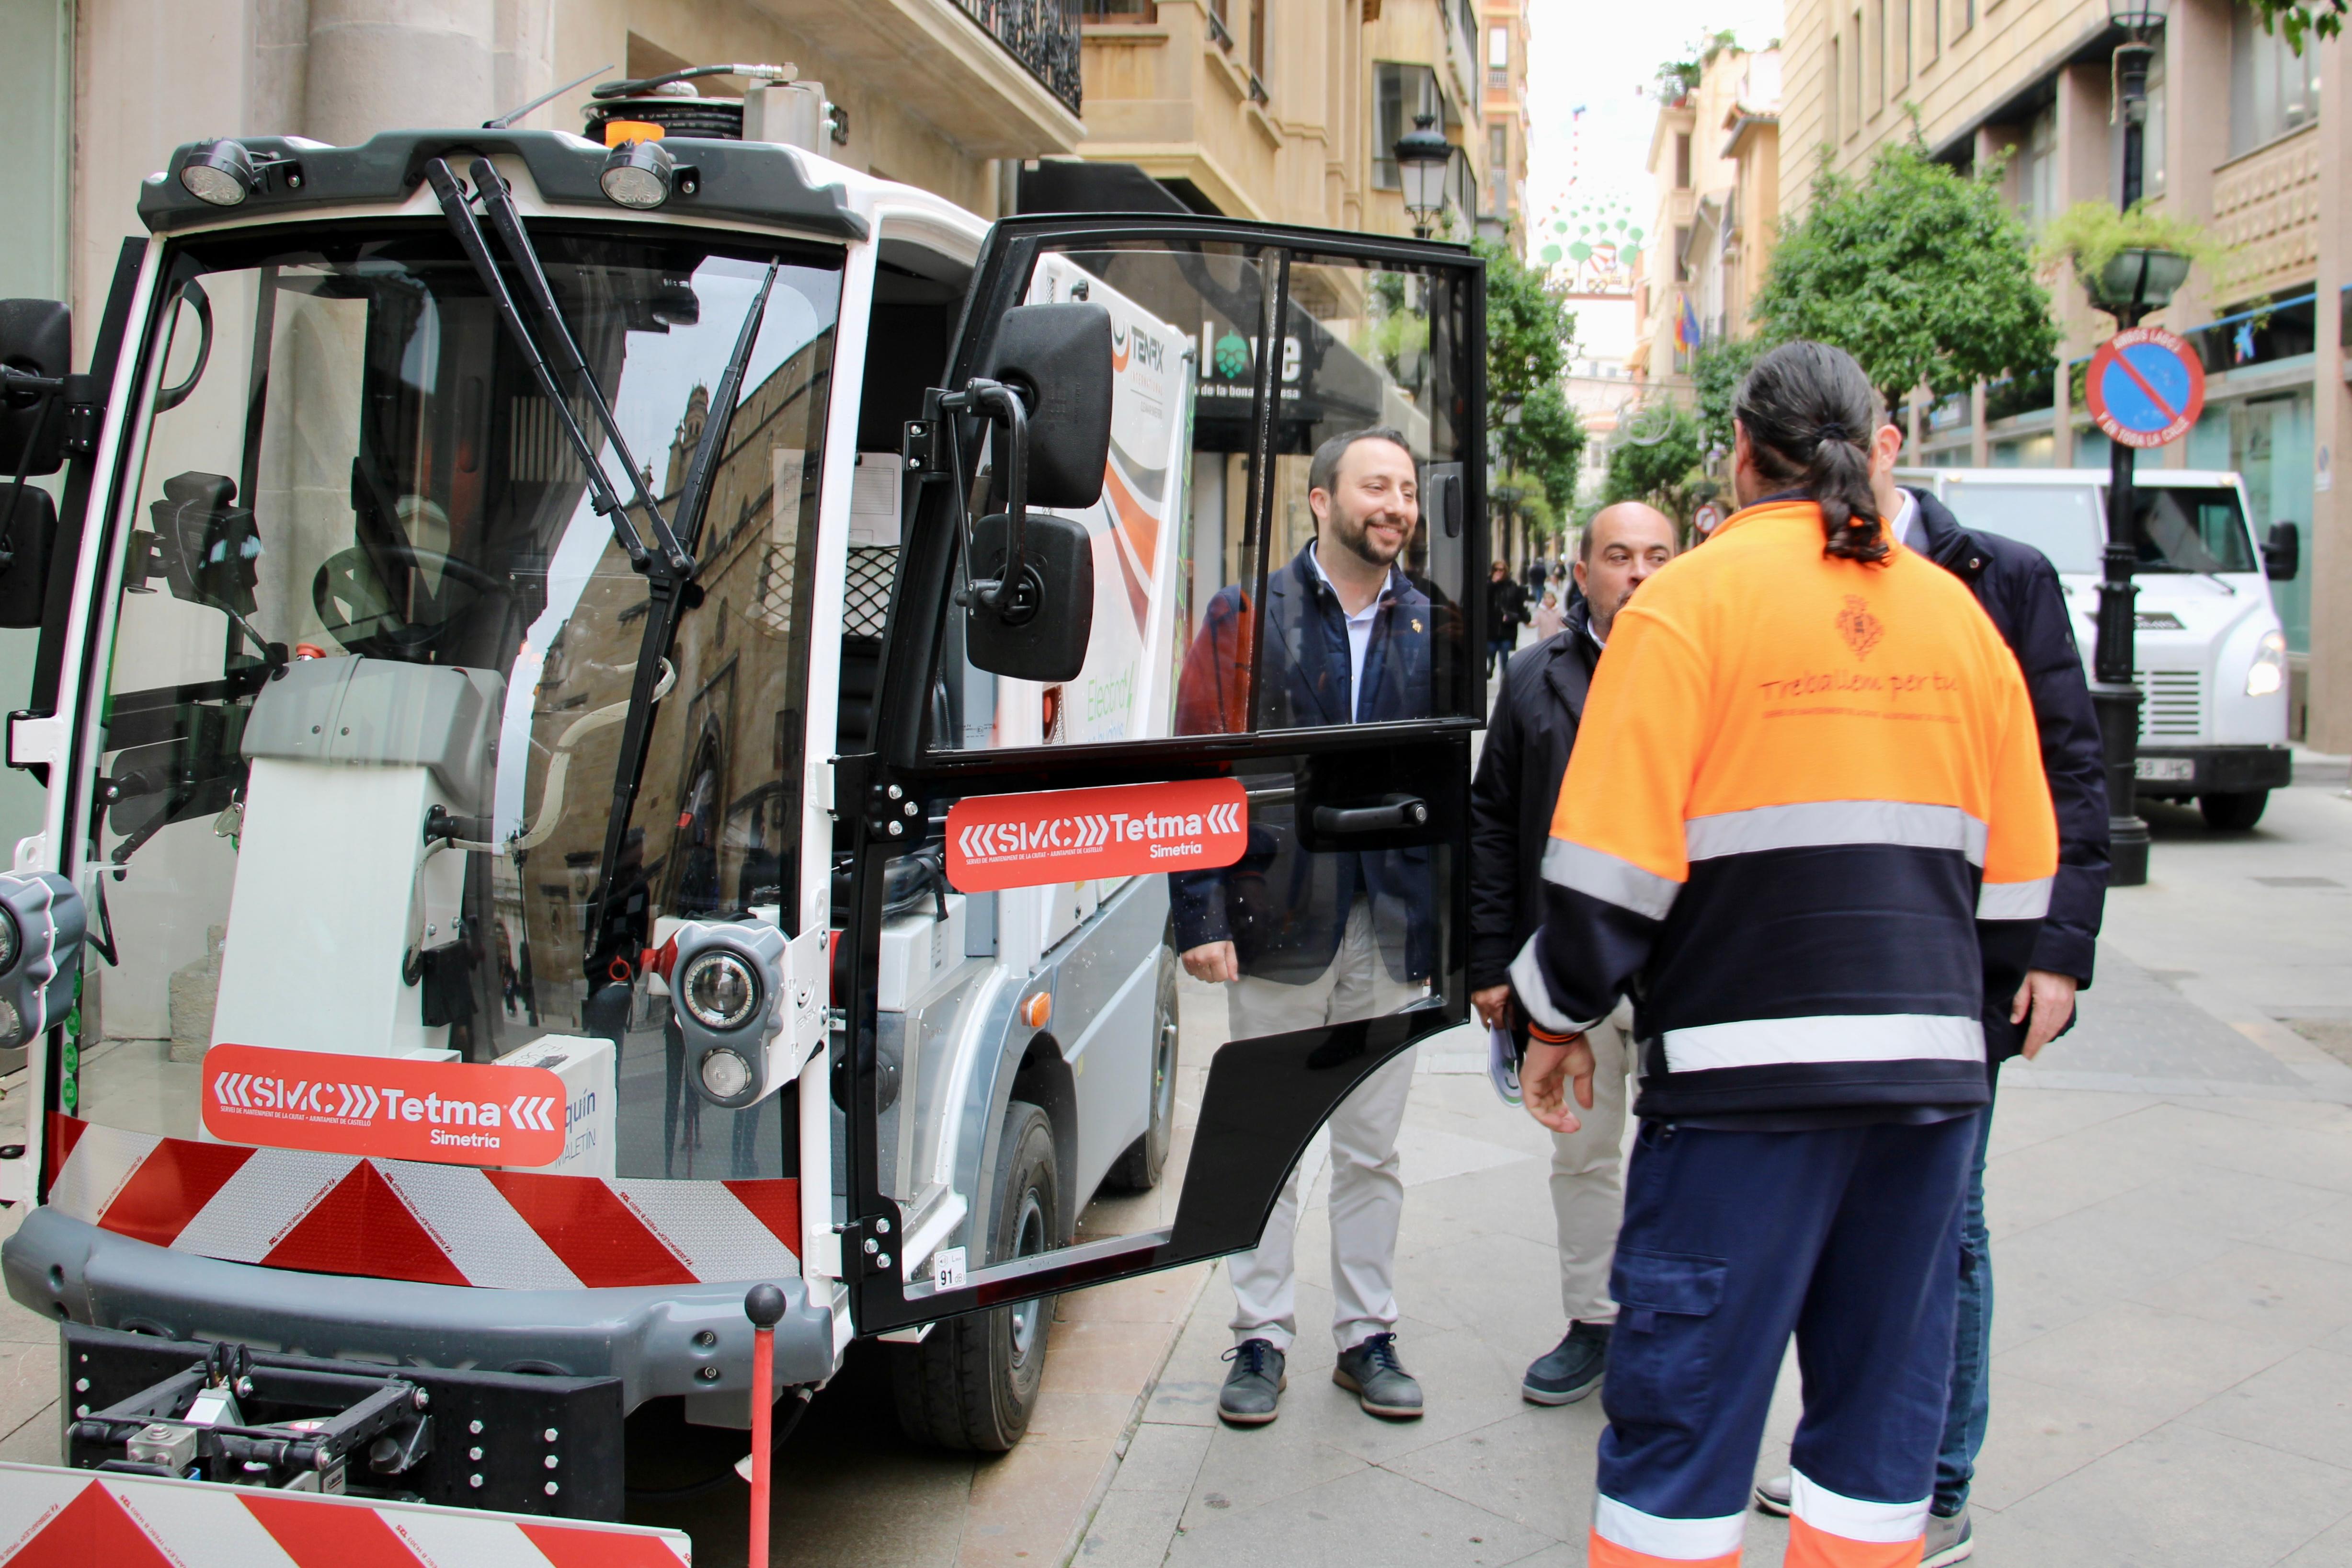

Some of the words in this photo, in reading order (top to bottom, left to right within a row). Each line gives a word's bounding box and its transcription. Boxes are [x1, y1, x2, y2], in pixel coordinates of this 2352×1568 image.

[1201, 384, 1215, 396] de
[1217, 384, 1226, 396] la
[1229, 385, 1254, 397] bona
[2102, 420, 2119, 434] EN
[2117, 429, 2145, 446] TODA
[2146, 435, 2161, 447] LA
[1889, 674, 1928, 702] per
[1932, 671, 1958, 690] tu
[1110, 811, 1202, 842] Tetma
[966, 857, 981, 865] SERVEI
[989, 855, 1018, 863] MANTENIMENT
[1150, 842, 1202, 859] Simetría
[243, 1108, 274, 1117] MANTENIMENT
[289, 1112, 305, 1120] CIUTAT
[309, 1115, 339, 1124] AJUNTAMENT
[381, 1088, 501, 1126] Tetma
[565, 1088, 595, 1133] quín
[430, 1129, 500, 1148] Simetría
[940, 1268, 953, 1285] 91
[955, 1273, 962, 1283] dB
